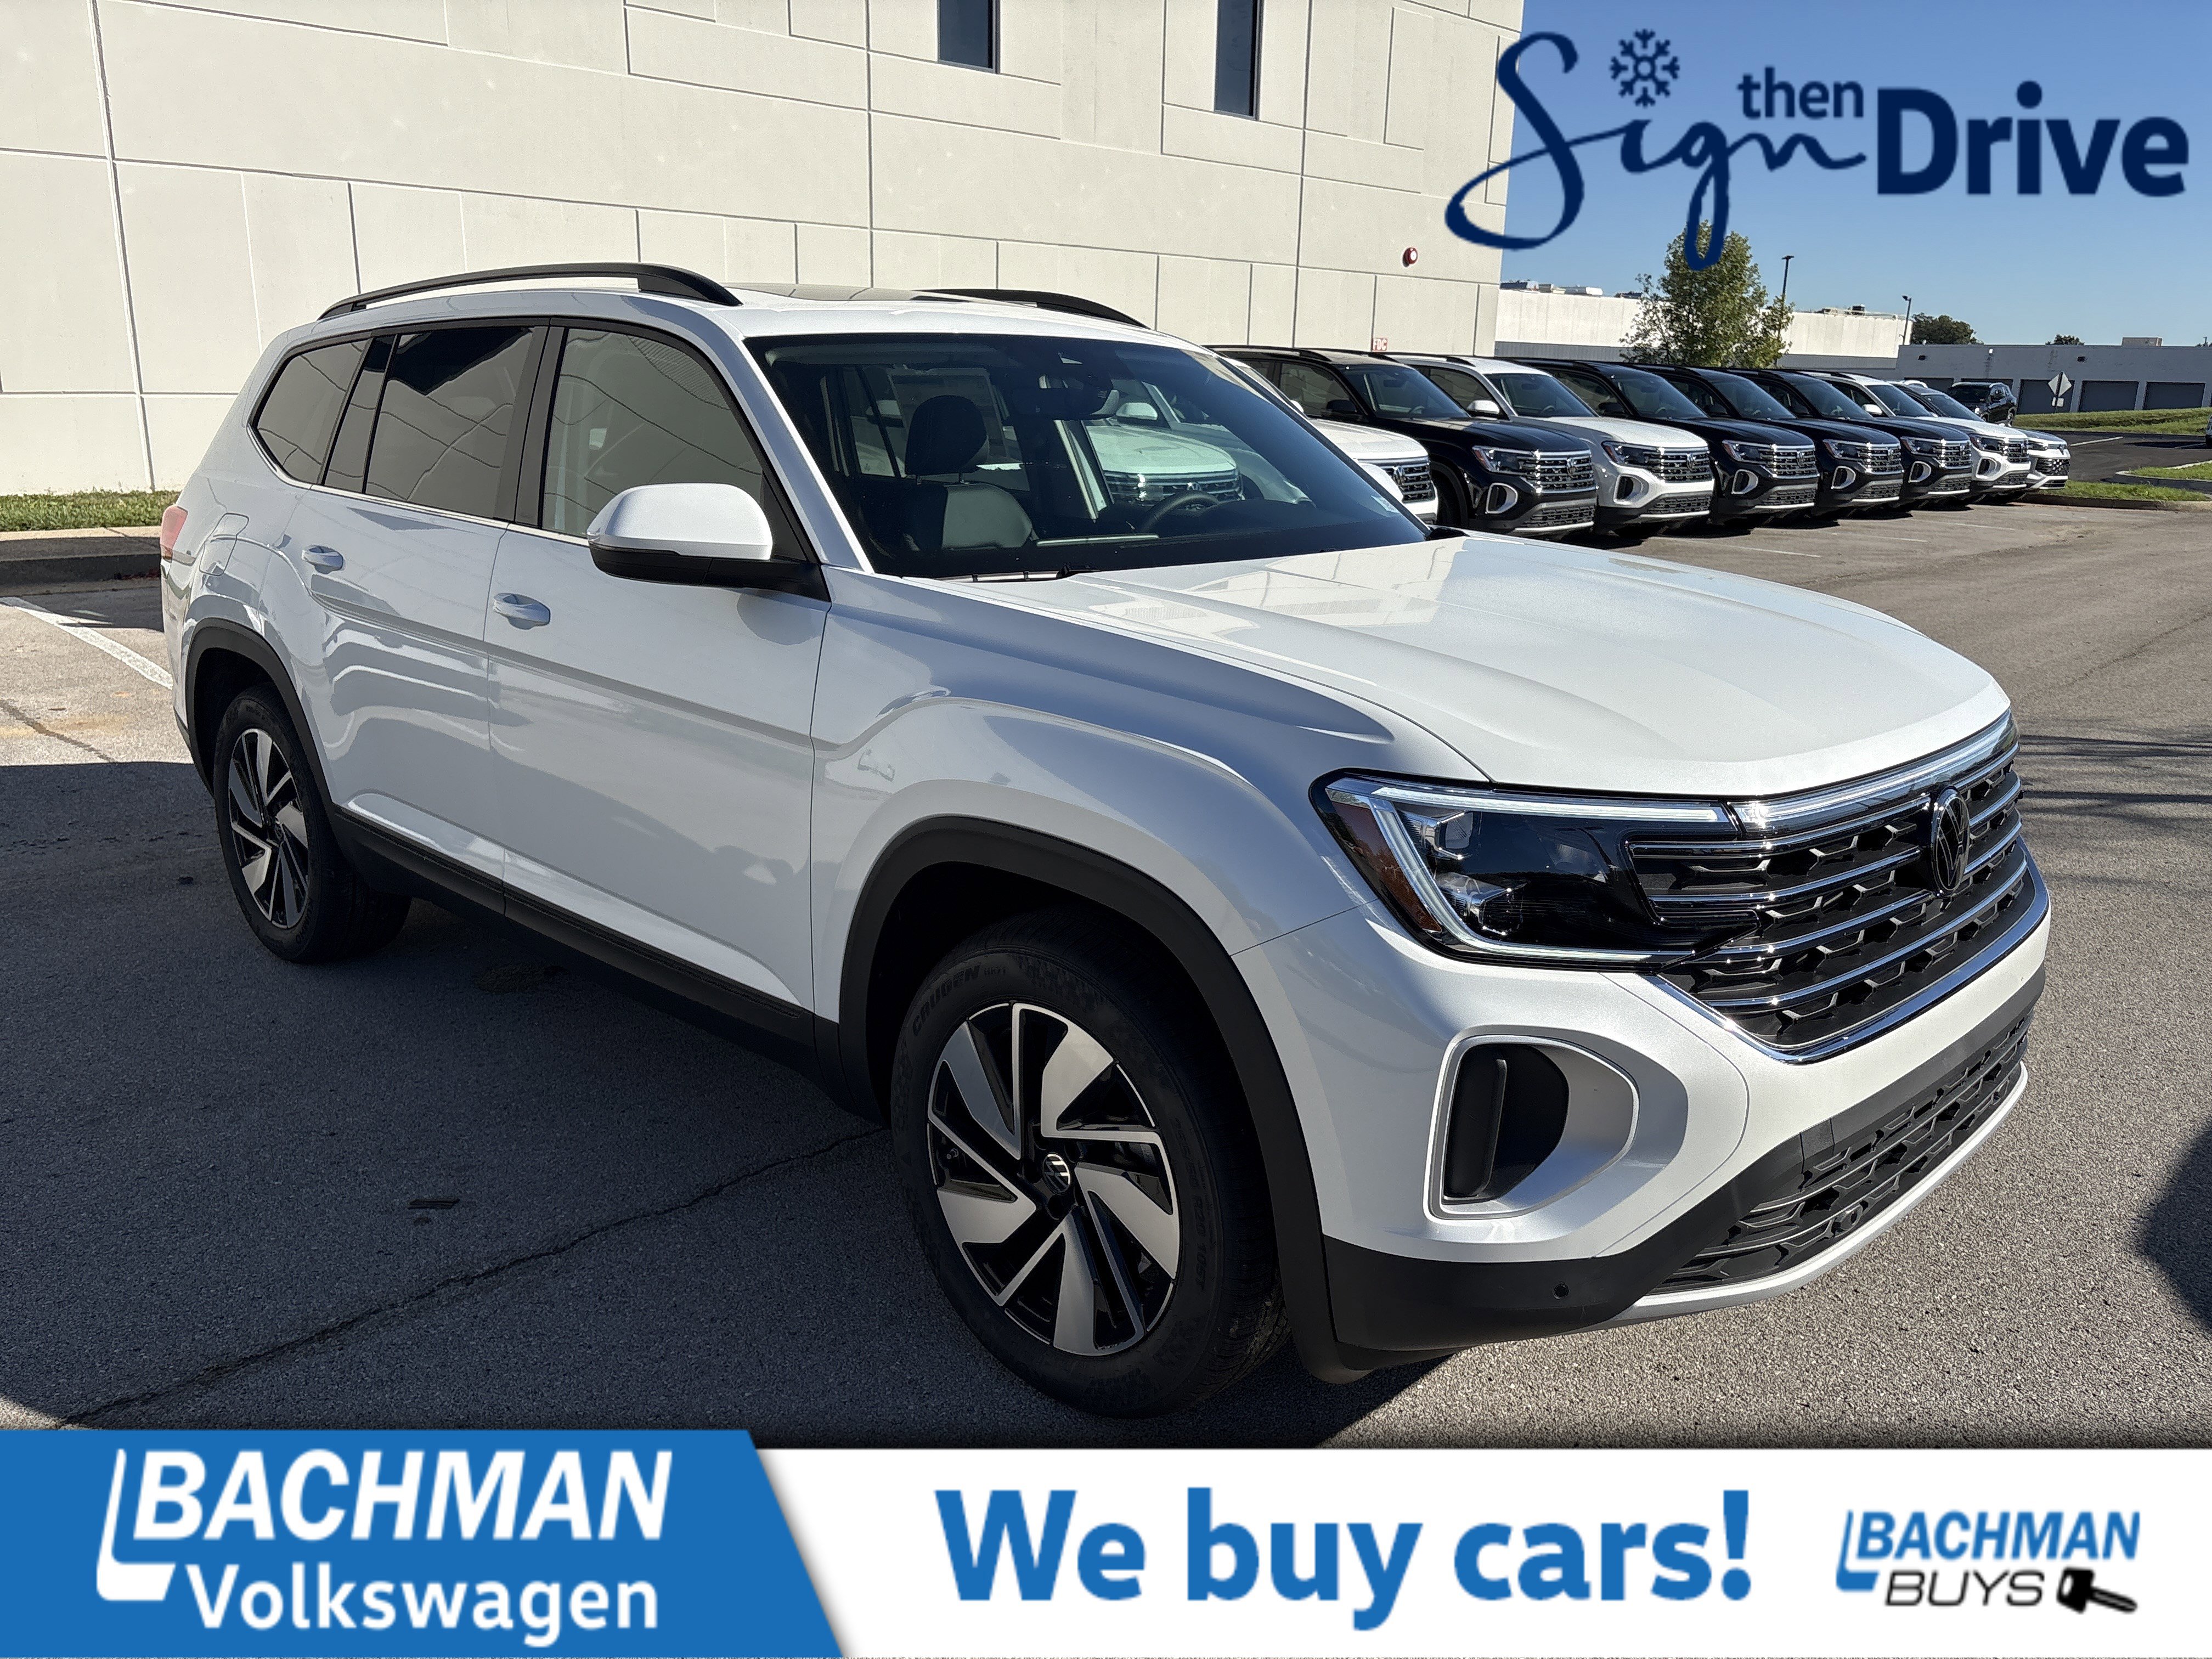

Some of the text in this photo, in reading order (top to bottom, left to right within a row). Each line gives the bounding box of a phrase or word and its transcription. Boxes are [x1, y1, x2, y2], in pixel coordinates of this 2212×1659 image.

[1373, 338, 1387, 351] FDC
[912, 963, 981, 1037] CRUGEN
[1190, 1194, 1207, 1238] R20
